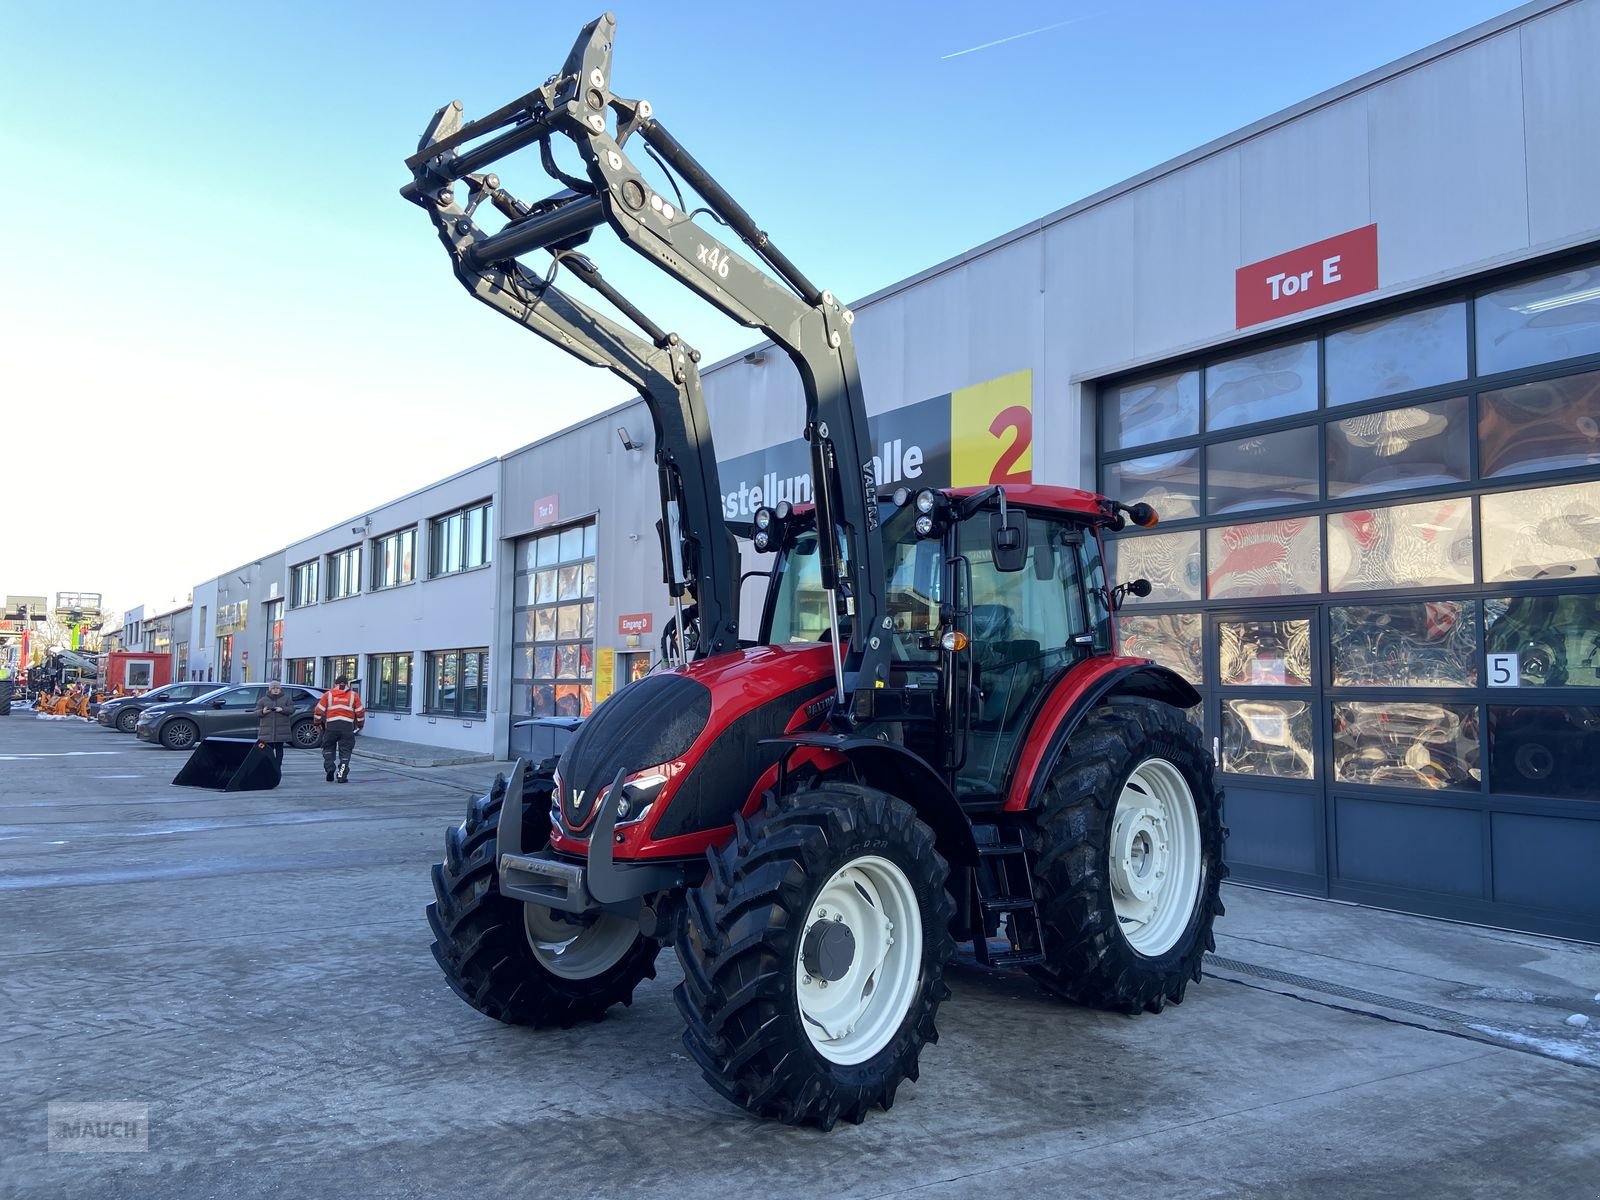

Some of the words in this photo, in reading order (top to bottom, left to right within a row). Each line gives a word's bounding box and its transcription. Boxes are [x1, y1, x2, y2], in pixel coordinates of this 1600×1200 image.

[697, 244, 729, 278] x46
[1266, 270, 1314, 301] Tor
[1322, 254, 1342, 286] E
[988, 405, 1032, 485] 2
[862, 459, 879, 531] VALTRA
[622, 620, 642, 631] Eingang
[642, 618, 647, 628] D
[1493, 657, 1511, 684] 5
